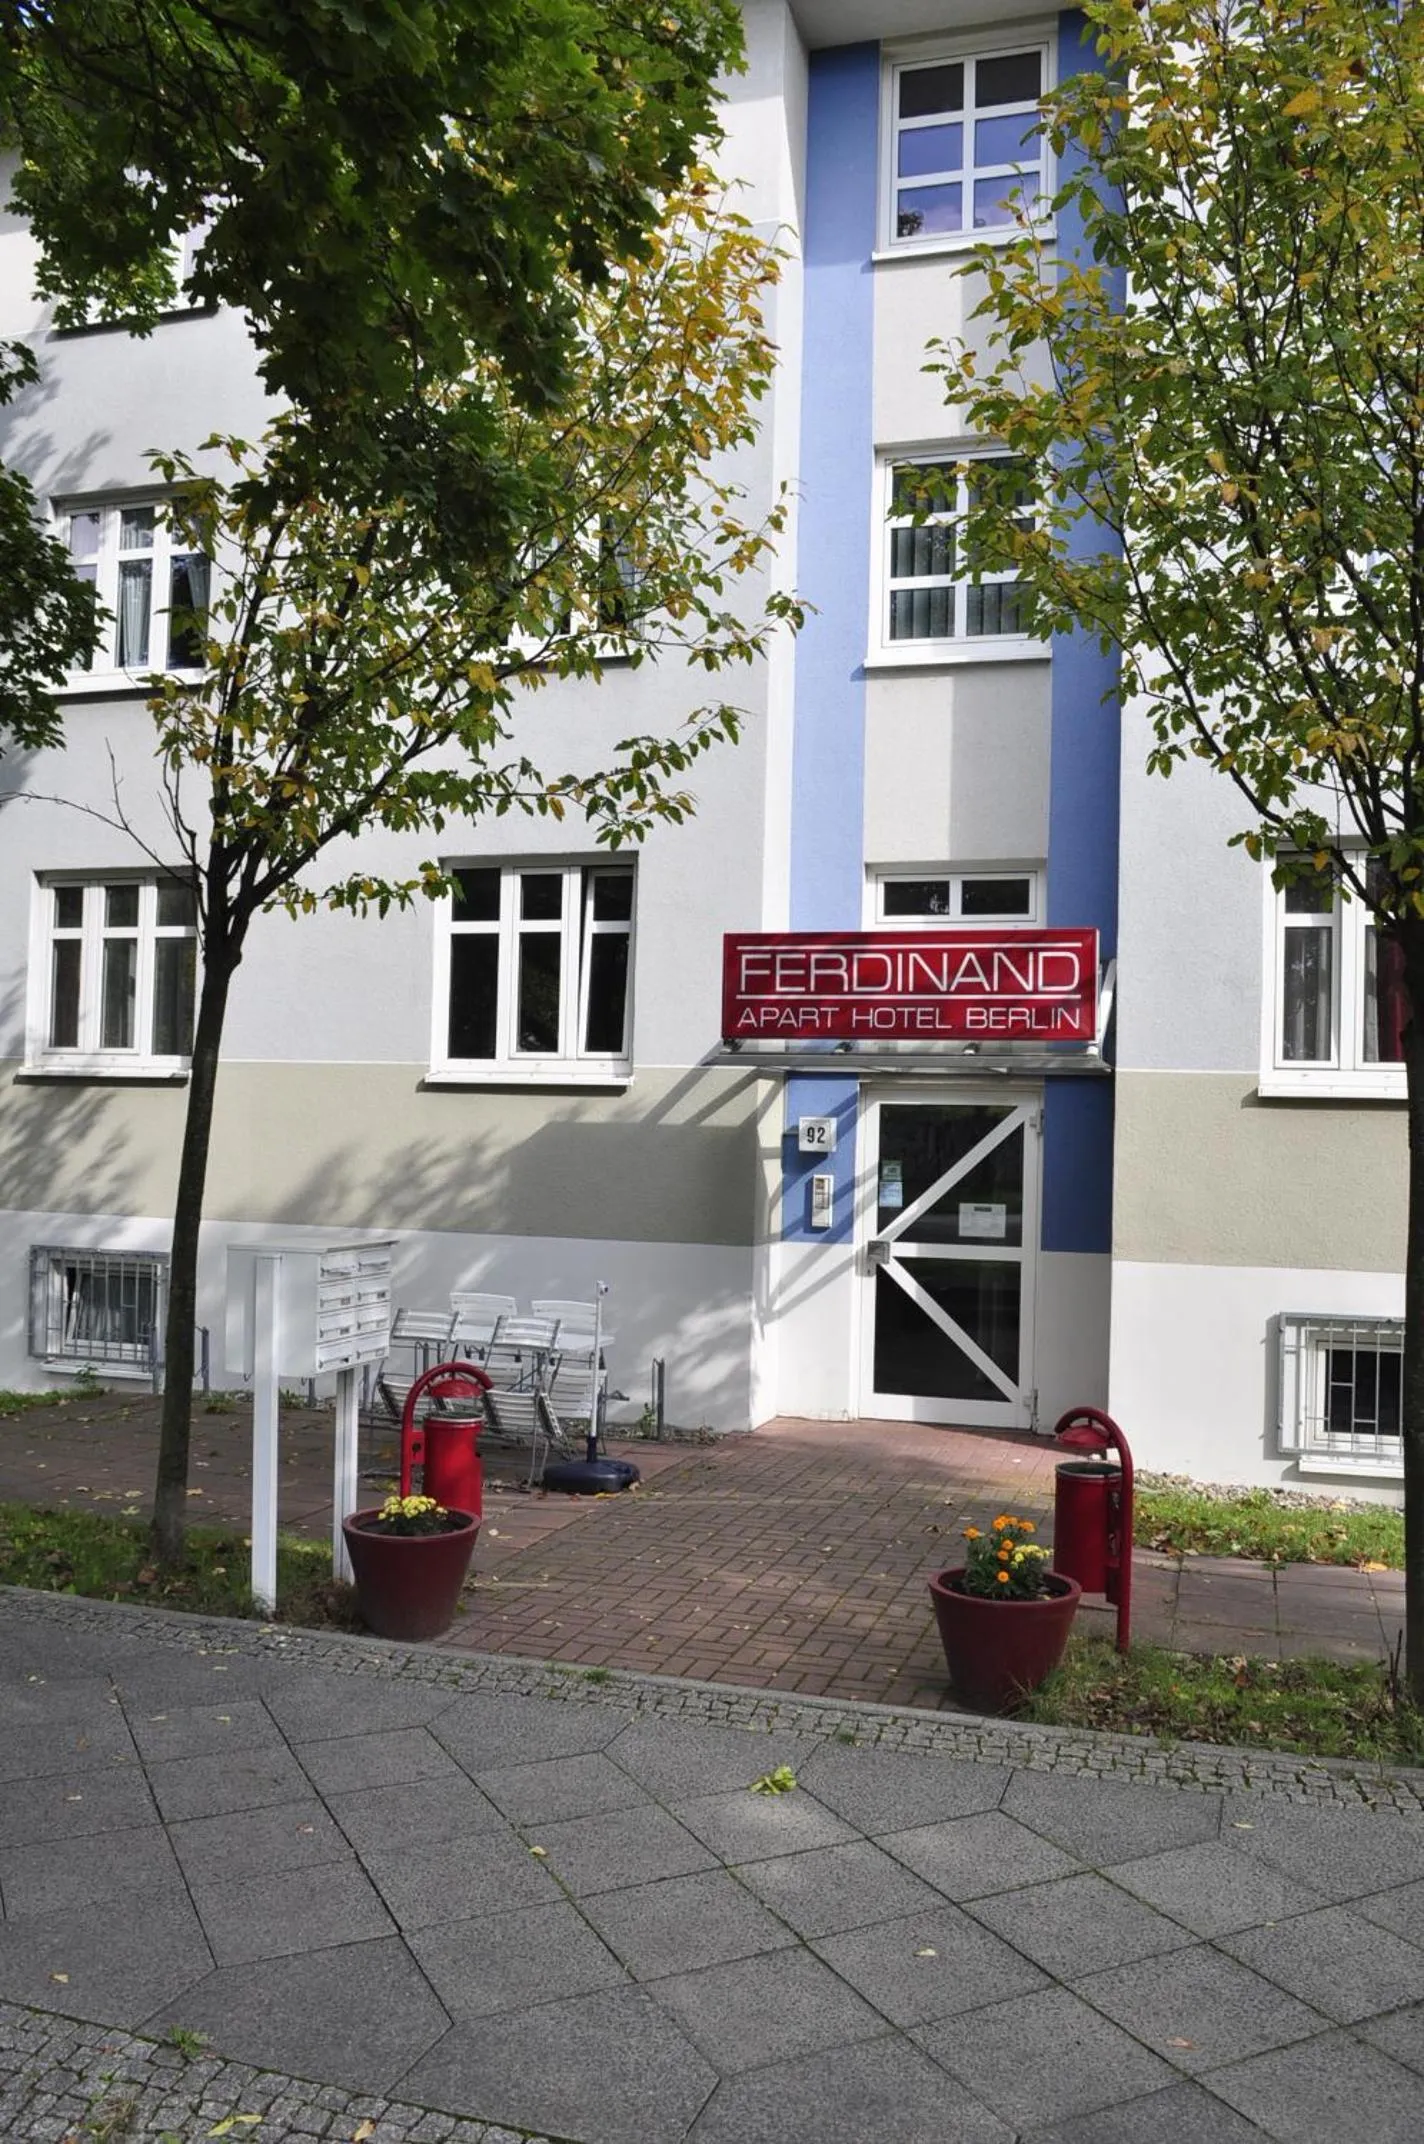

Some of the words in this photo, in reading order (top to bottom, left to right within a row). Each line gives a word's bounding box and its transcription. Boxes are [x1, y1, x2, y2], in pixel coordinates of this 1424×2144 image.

[739, 951, 1082, 993] FERDINAND
[737, 1007, 840, 1029] APART
[851, 1007, 952, 1029] HOTEL
[965, 1007, 1081, 1029] BERLIN
[806, 1126, 826, 1144] 92
